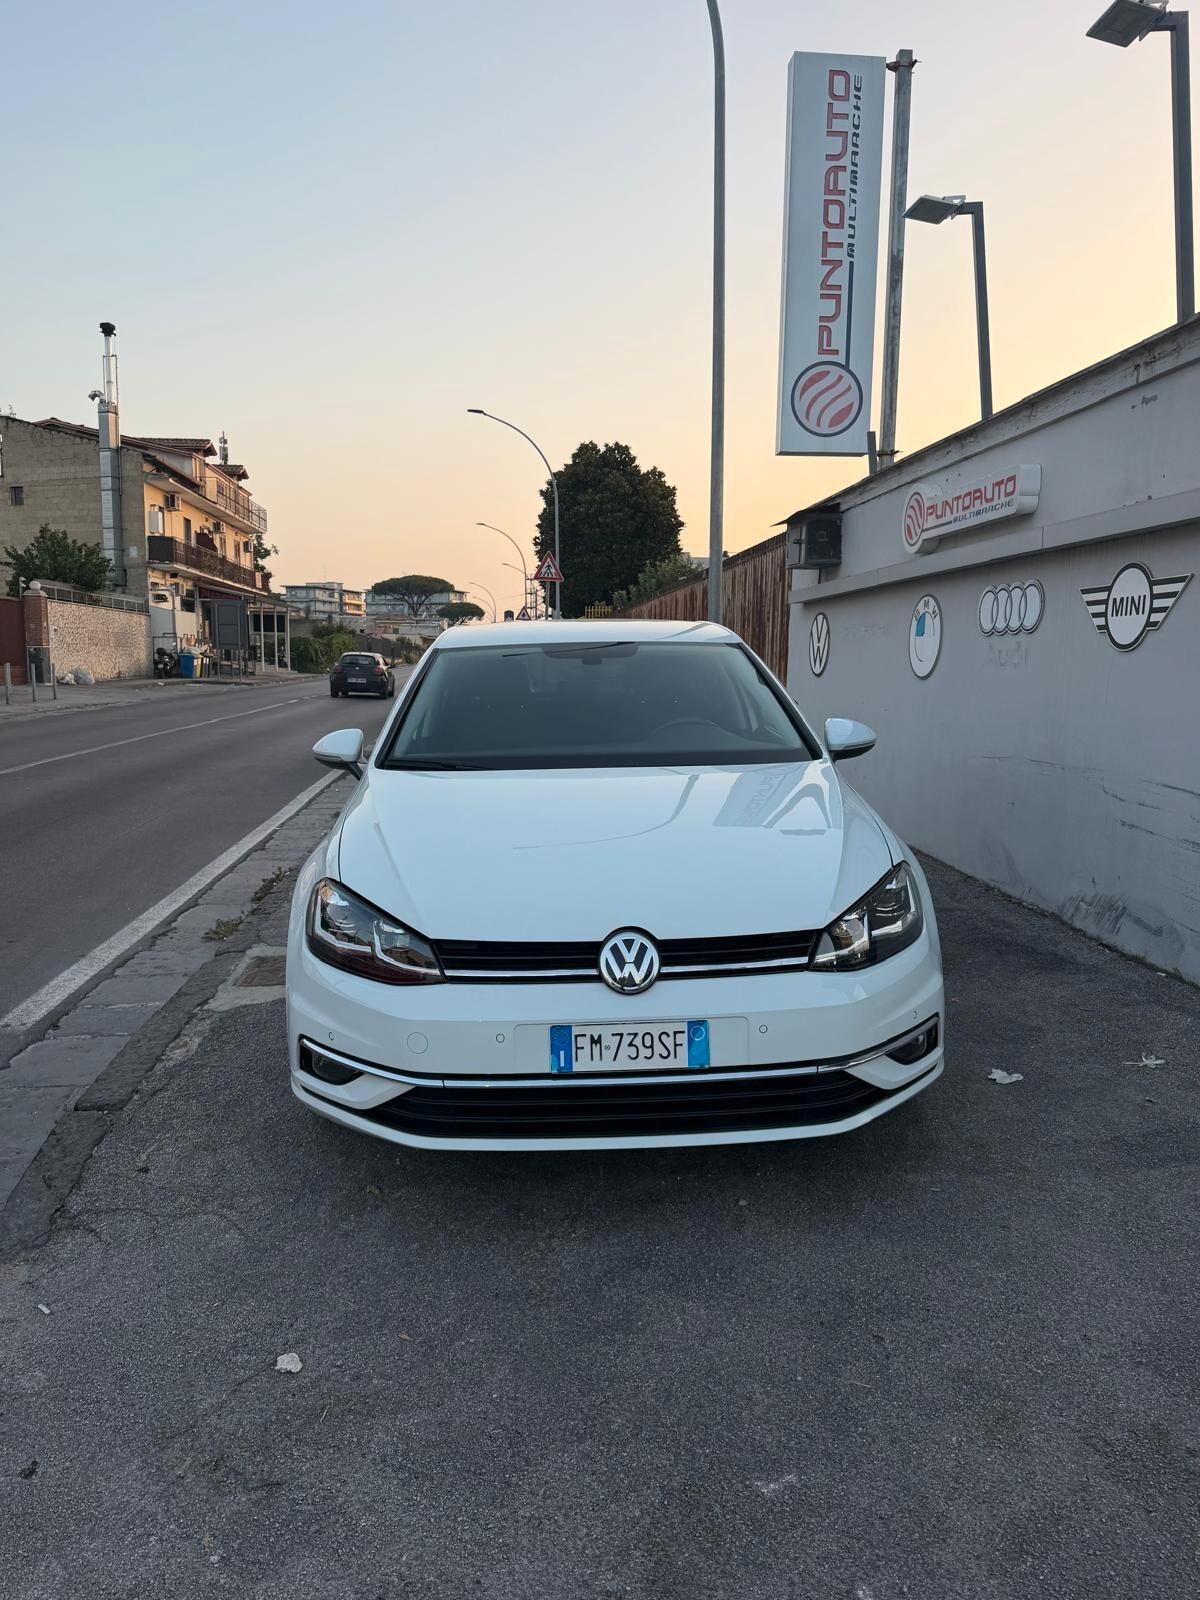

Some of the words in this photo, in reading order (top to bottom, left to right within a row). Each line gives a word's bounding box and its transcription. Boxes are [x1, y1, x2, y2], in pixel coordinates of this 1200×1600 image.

[846, 74, 864, 260] MULTIMARCHE
[817, 68, 851, 356] PUNTOAUTO
[925, 474, 1017, 524] PUNTOAUTO
[914, 599, 938, 622] BMW
[1110, 594, 1147, 618] MINI
